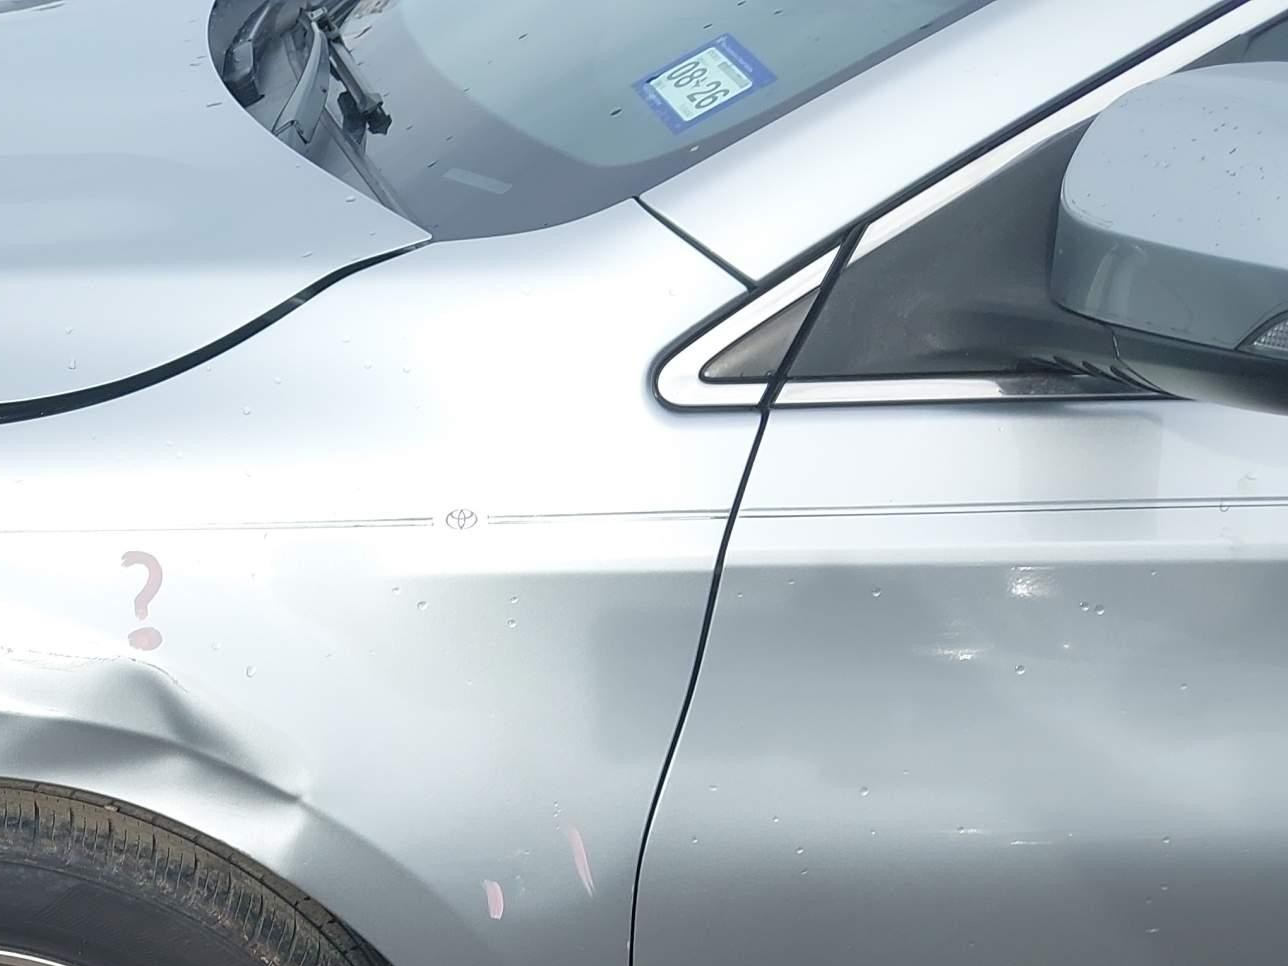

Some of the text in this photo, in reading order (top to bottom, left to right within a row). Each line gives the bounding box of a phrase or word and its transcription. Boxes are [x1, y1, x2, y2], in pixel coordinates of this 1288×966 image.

[666, 60, 730, 110] 08 26
[120, 550, 163, 651] ?
